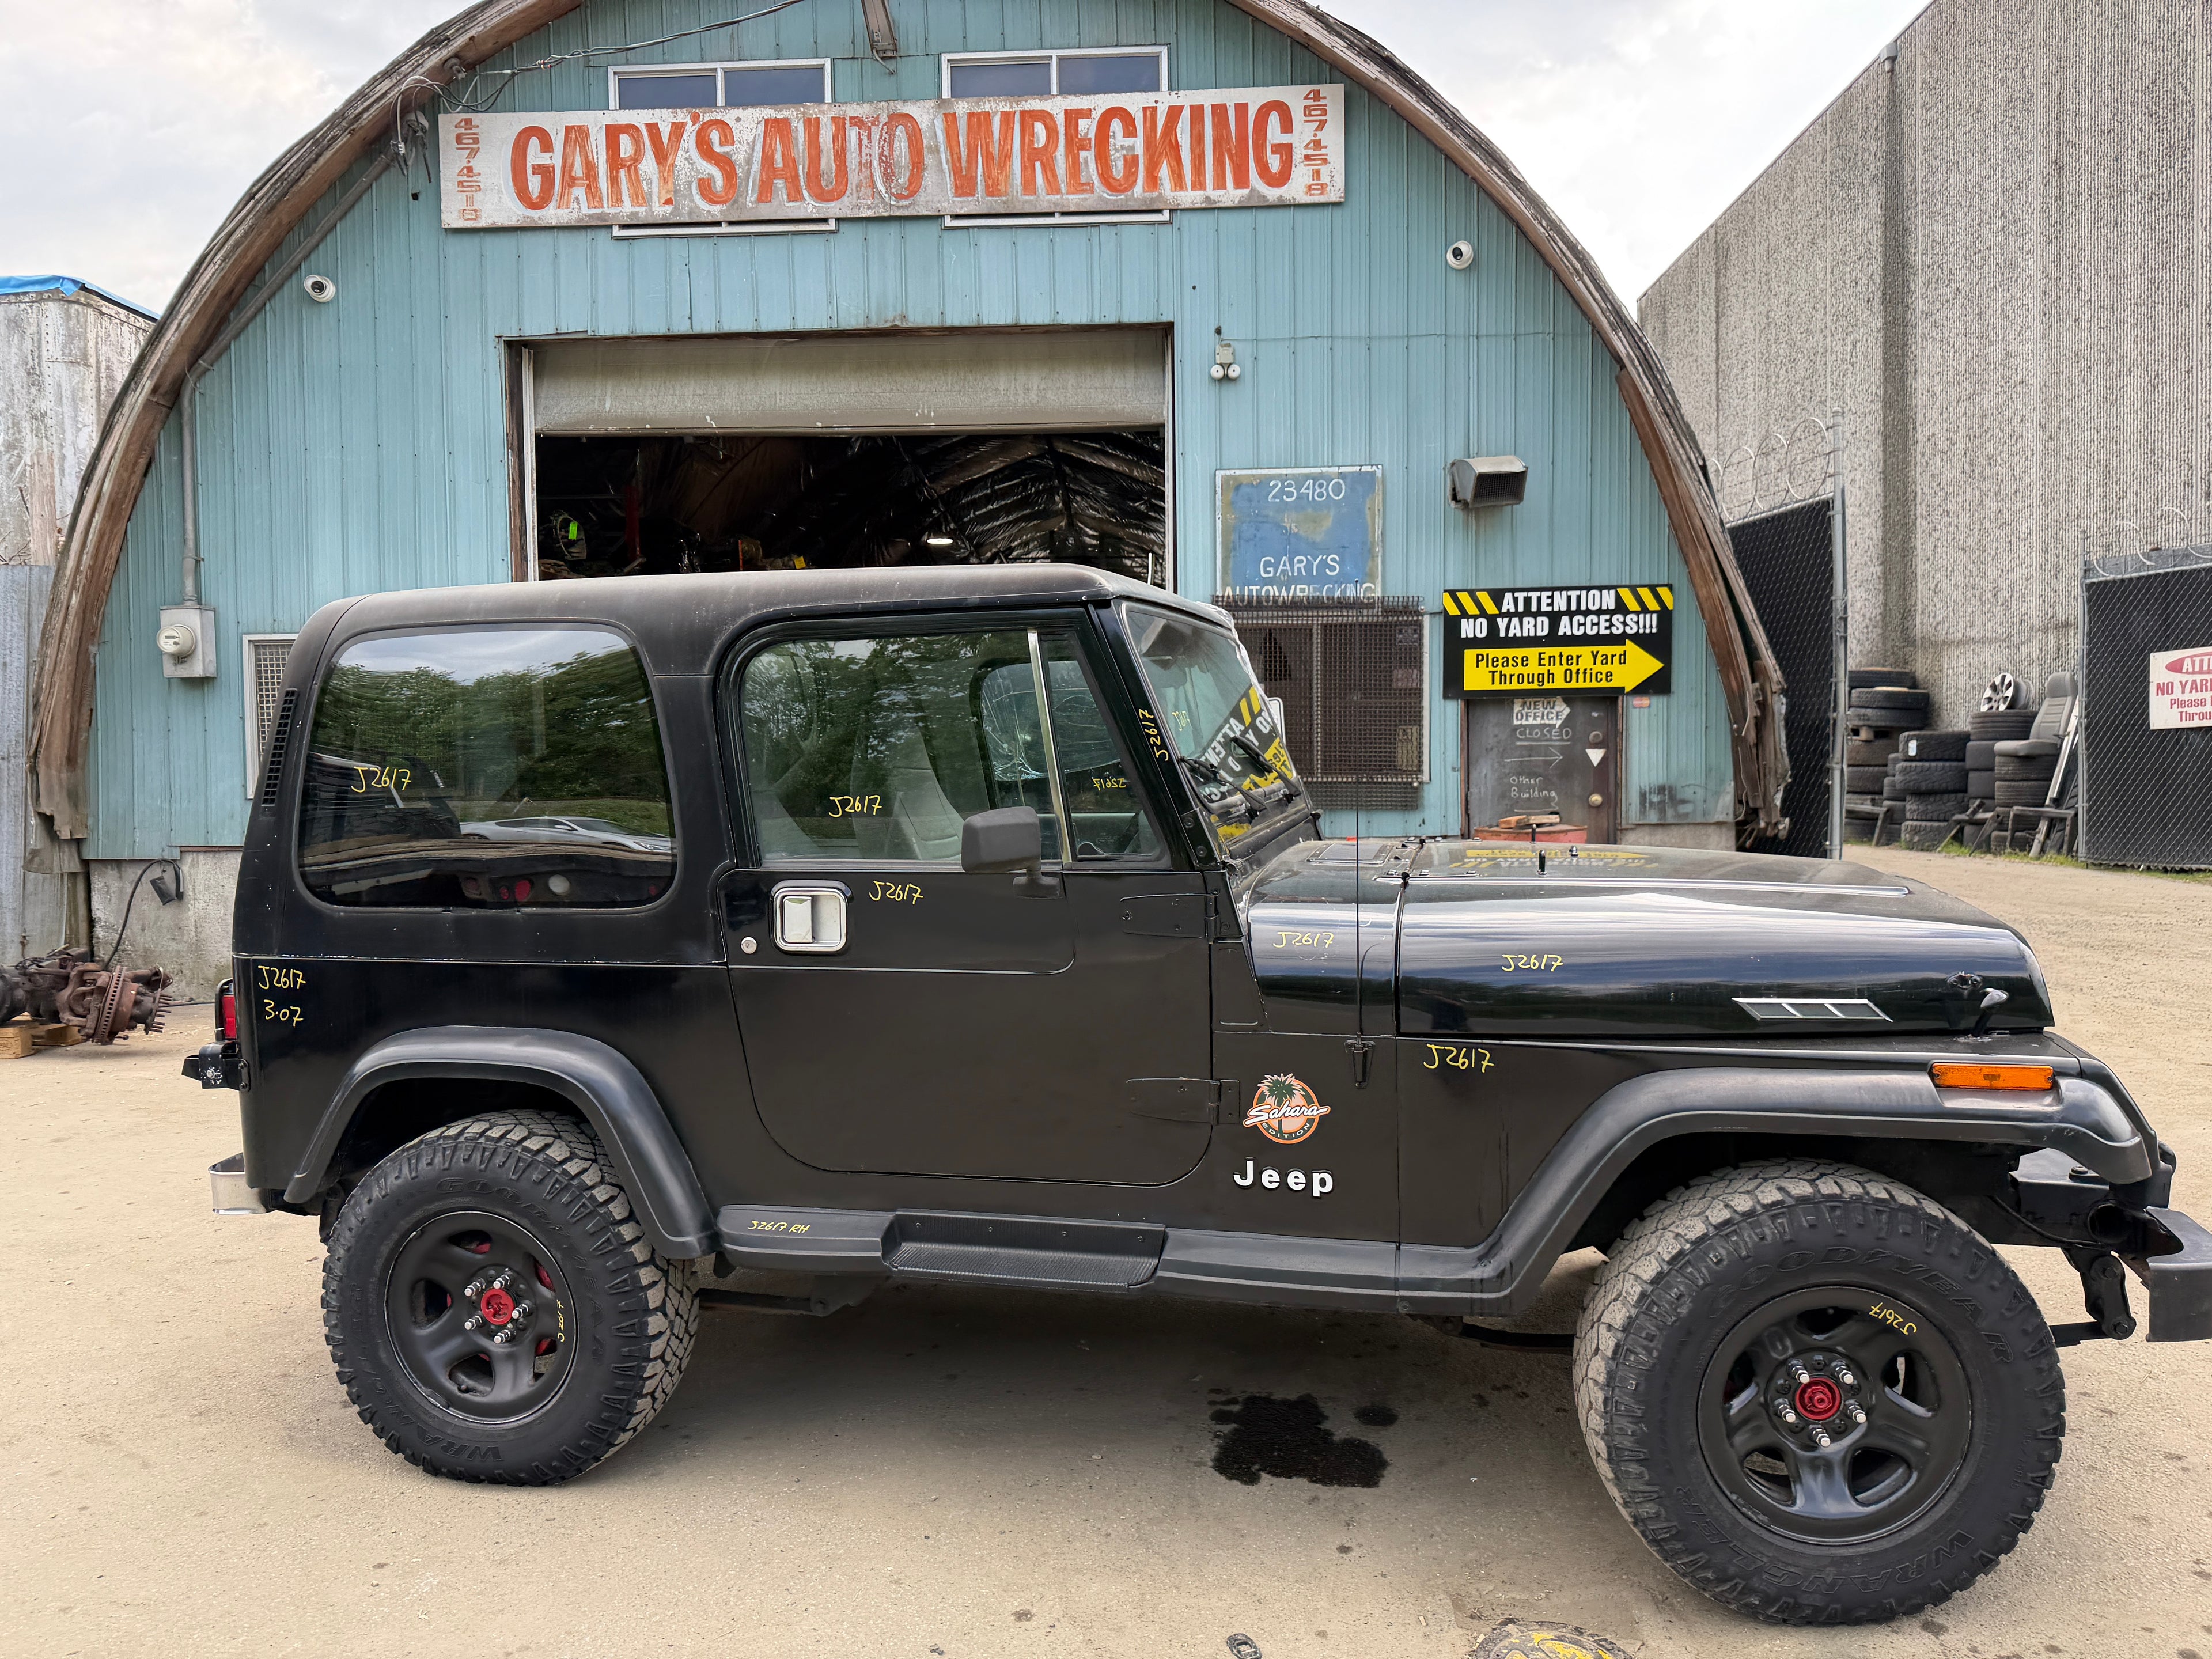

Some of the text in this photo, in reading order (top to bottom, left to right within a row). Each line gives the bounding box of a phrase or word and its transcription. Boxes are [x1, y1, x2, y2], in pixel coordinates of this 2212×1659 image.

[509, 100, 1294, 211] GARY'S AUTO WRECKING
[1267, 478, 1346, 502] 23480
[1259, 554, 1340, 578] GARY'S
[1501, 589, 1616, 613] ATTENTION
[1460, 613, 1658, 638] NO YARD ACCESS!!!
[1475, 649, 1627, 669] Please Enter Yard
[1488, 668, 1613, 687] Through Office
[2156, 681, 2175, 696] NO
[1522, 700, 1556, 710] NEW
[2169, 698, 2207, 710] Please
[1515, 710, 1564, 722] OFFICE
[1138, 709, 1169, 762] J2617
[1516, 726, 1572, 740] CLOSED
[351, 766, 412, 793] J2617
[1509, 776, 1544, 785] Other
[828, 794, 882, 817] J2617
[1510, 787, 1559, 802] Building
[869, 880, 924, 905] J2617
[1272, 931, 1335, 948] J2617
[1501, 954, 1564, 972] J2617
[257, 965, 306, 990] J2617
[1423, 1044, 1495, 1073] J2617
[1244, 1100, 1330, 1126] Sahara
[1261, 1122, 1310, 1139] EDITION
[1233, 1158, 1334, 1198] Jeep
[747, 1220, 811, 1234] J2617 RH
[1868, 1302, 1918, 1335] J2617
